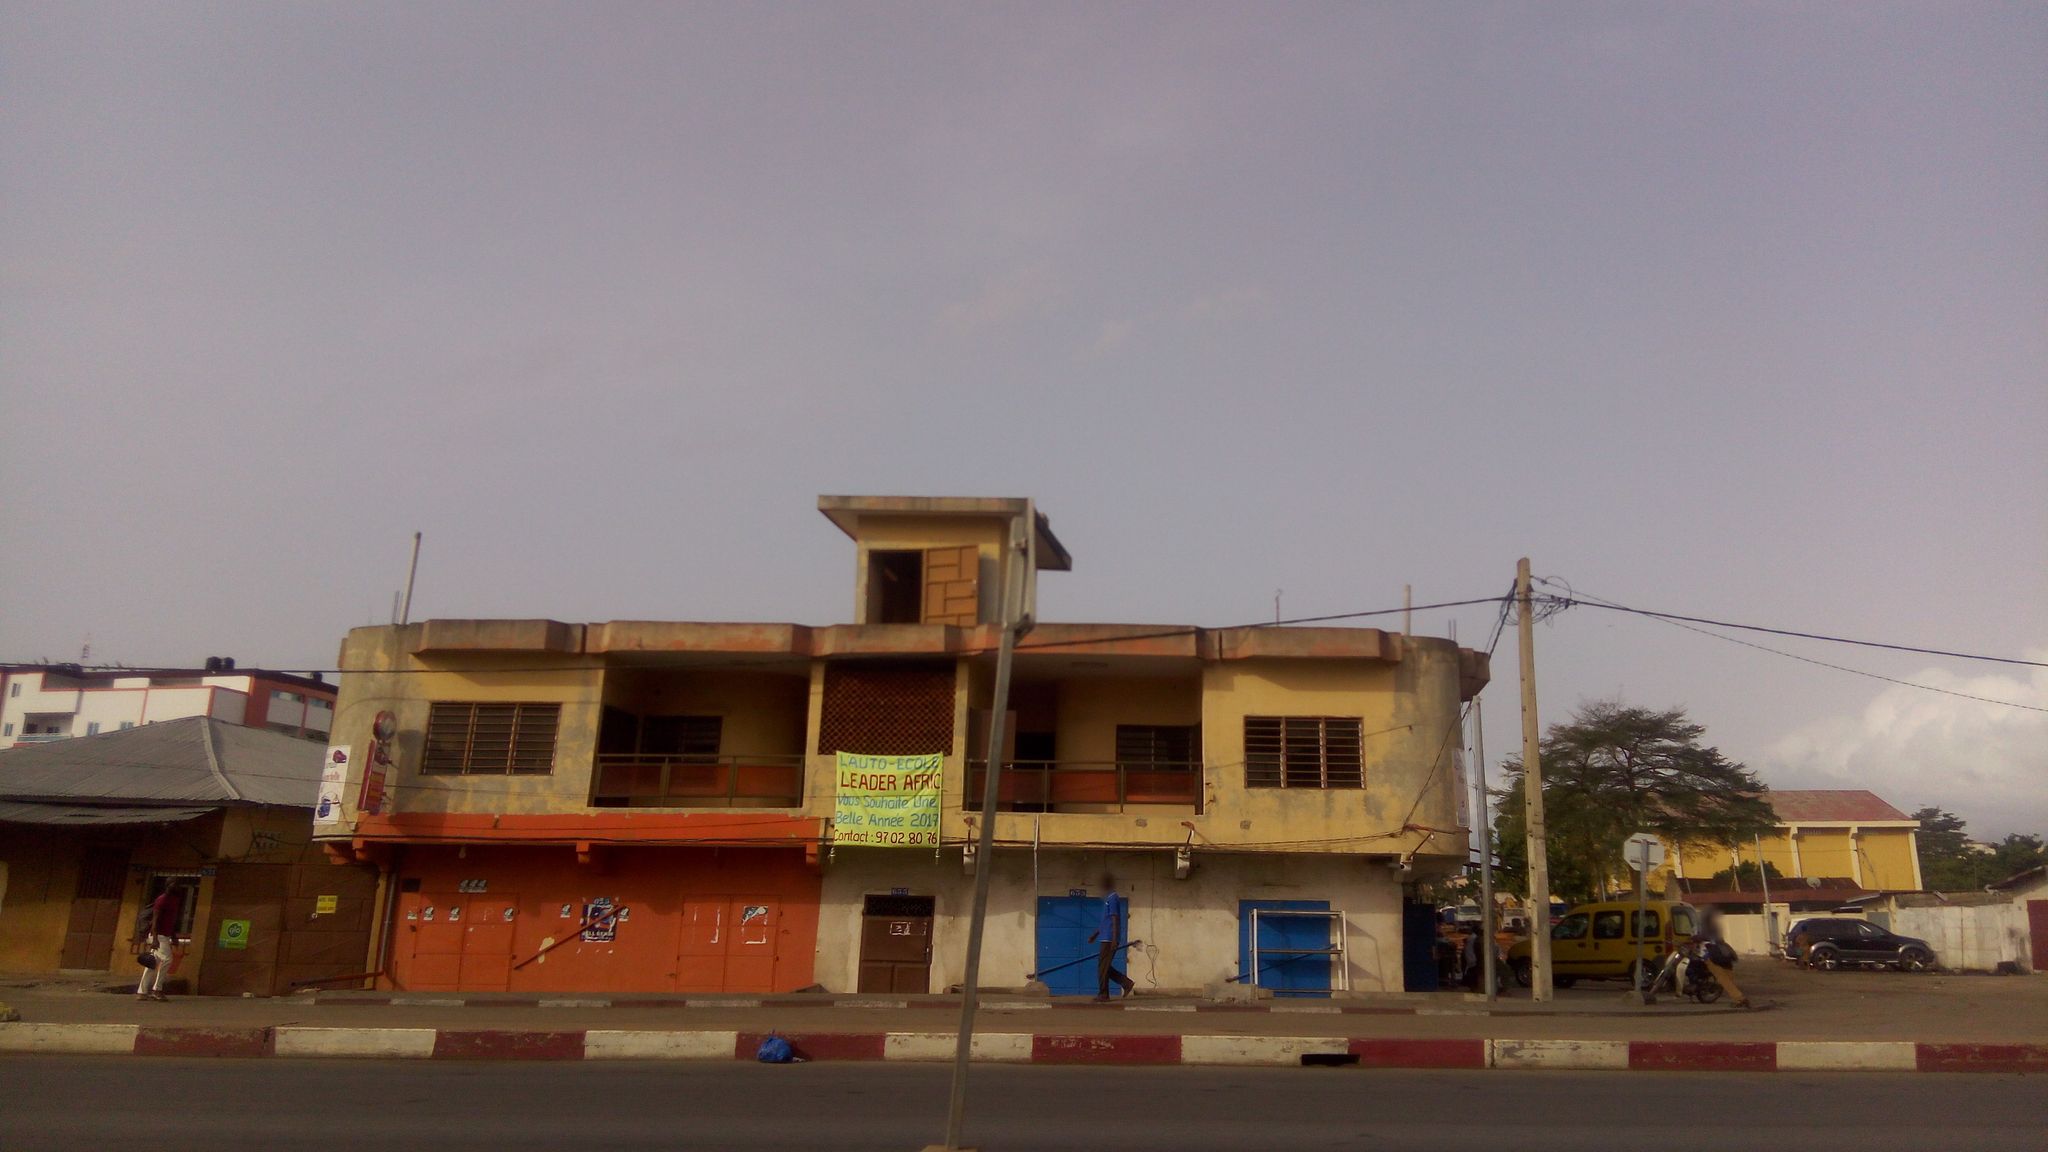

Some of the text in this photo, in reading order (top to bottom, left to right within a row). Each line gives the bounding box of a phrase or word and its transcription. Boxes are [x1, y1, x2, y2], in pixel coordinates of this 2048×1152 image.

[840, 771, 897, 791] LEADER
[837, 793, 860, 807] Vous
[864, 795, 909, 810] Souhaite
[835, 810, 939, 828] Belle Année 2017
[875, 831, 888, 844] 97
[890, 832, 905, 844] 02
[908, 832, 923, 845] 80
[927, 832, 938, 845] 76
